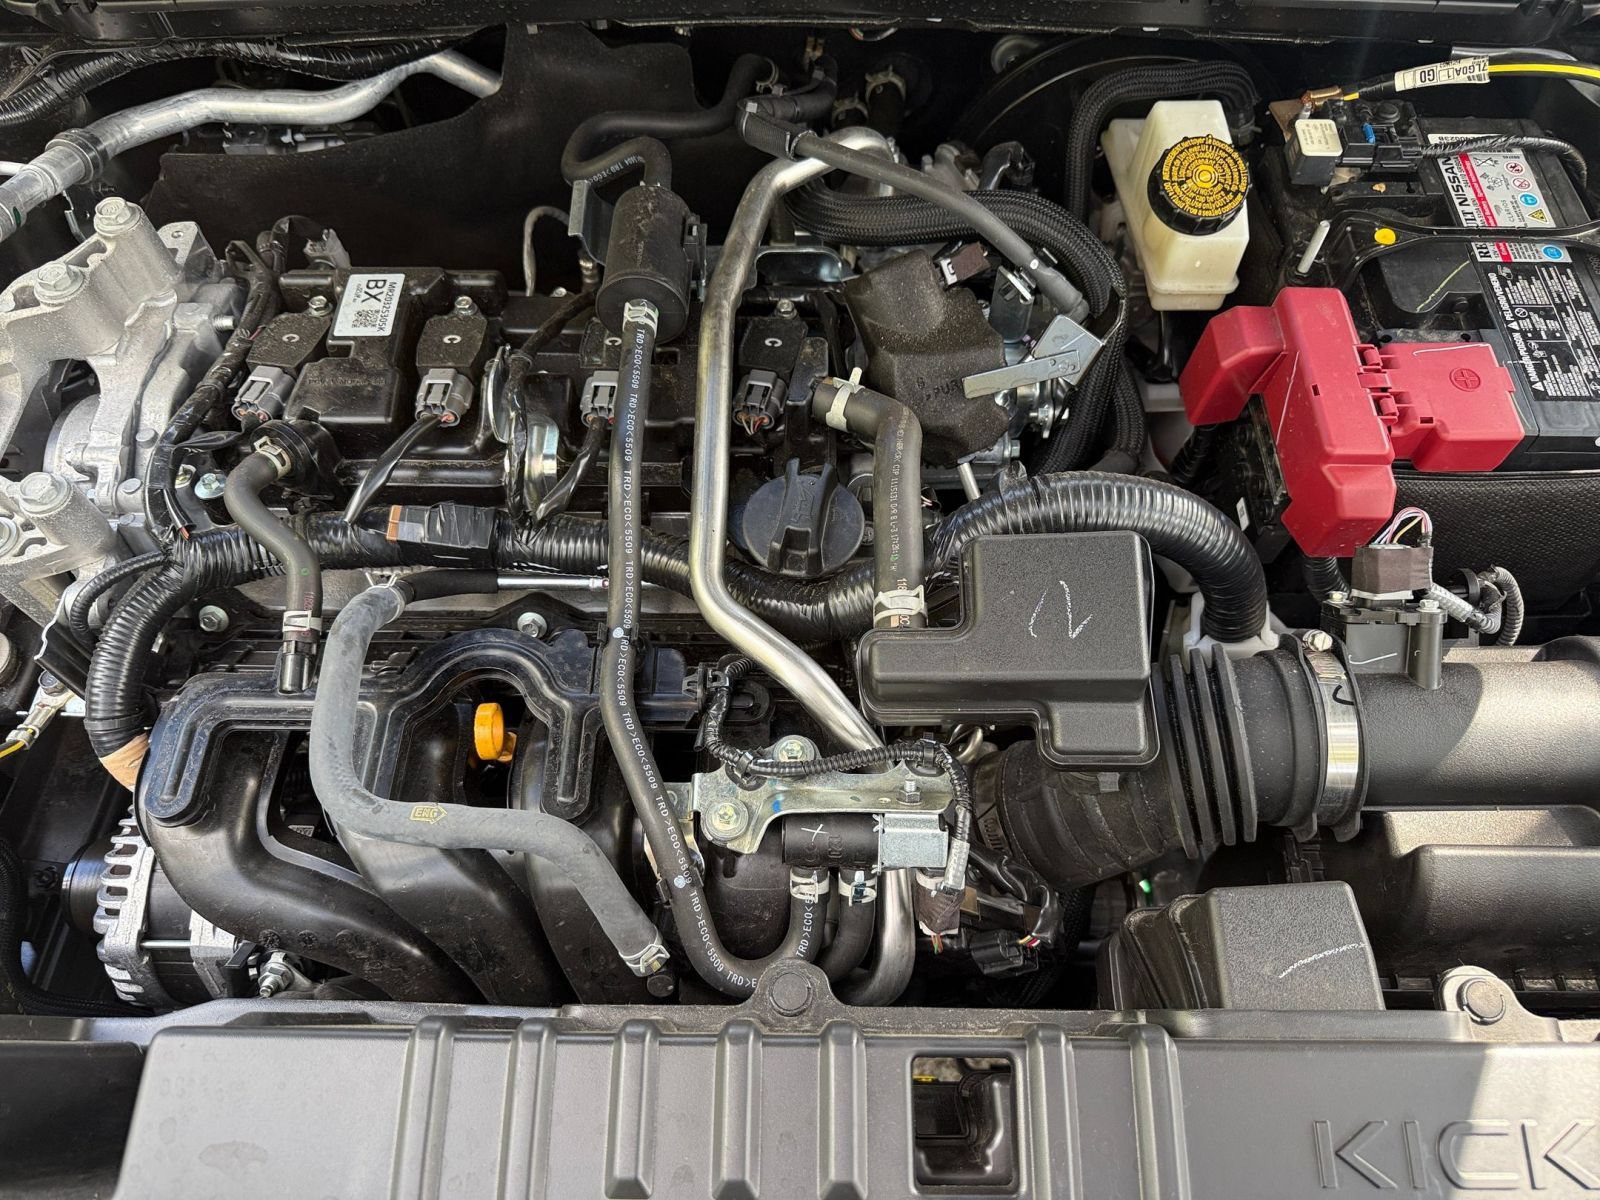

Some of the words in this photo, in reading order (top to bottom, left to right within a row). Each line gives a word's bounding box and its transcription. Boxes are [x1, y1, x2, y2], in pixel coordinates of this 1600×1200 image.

[1439, 156, 1470, 206] NISSAN
[1499, 198, 1516, 222] CLARIOS
[361, 279, 388, 304] BX
[1487, 272, 1515, 321] PELIGRO/VENENO
[1512, 332, 1540, 382] DANGER/POISON
[414, 807, 439, 818] ENG
[725, 970, 757, 989] TRD>E
[1312, 1119, 1600, 1191] KICK
